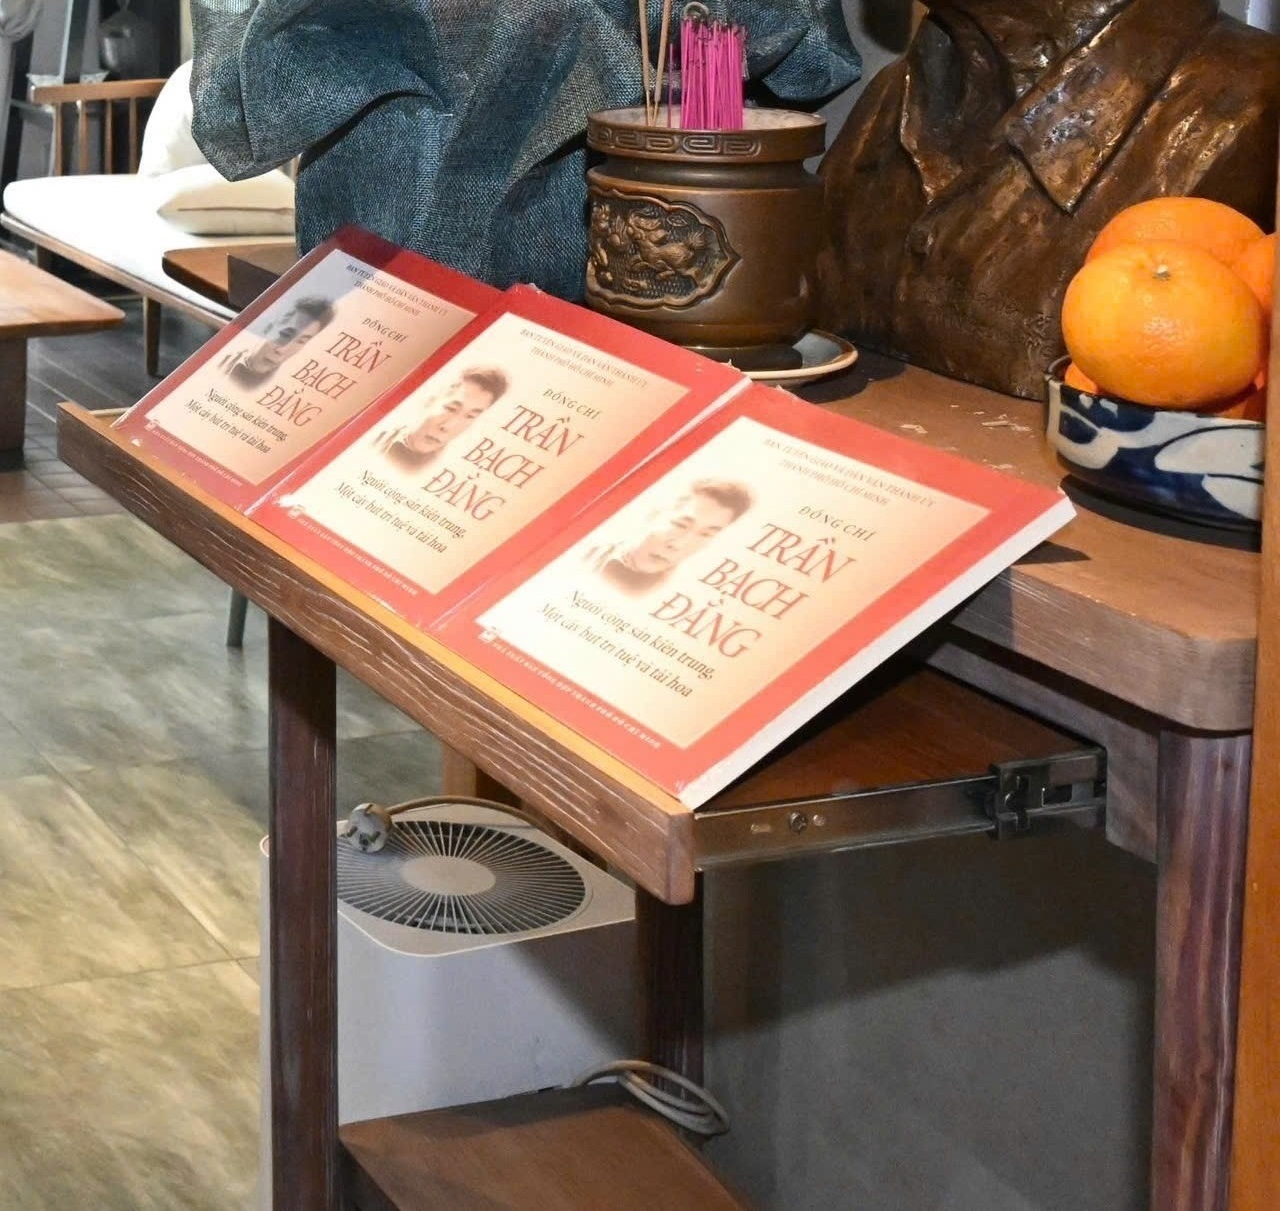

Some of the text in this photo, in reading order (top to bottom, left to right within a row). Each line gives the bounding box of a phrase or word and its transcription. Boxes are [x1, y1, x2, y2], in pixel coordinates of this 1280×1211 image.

[325, 332, 392, 373] TRẦN
[292, 359, 358, 399] BẠCH
[258, 386, 322, 426] ĐẰNG
[501, 406, 585, 457] TRẦN
[462, 437, 545, 488] BẠCH
[422, 469, 506, 521] ĐẰNG
[746, 523, 856, 583] TRẦN
[699, 558, 809, 620] BẠCH
[649, 592, 761, 659] ĐẰNG
